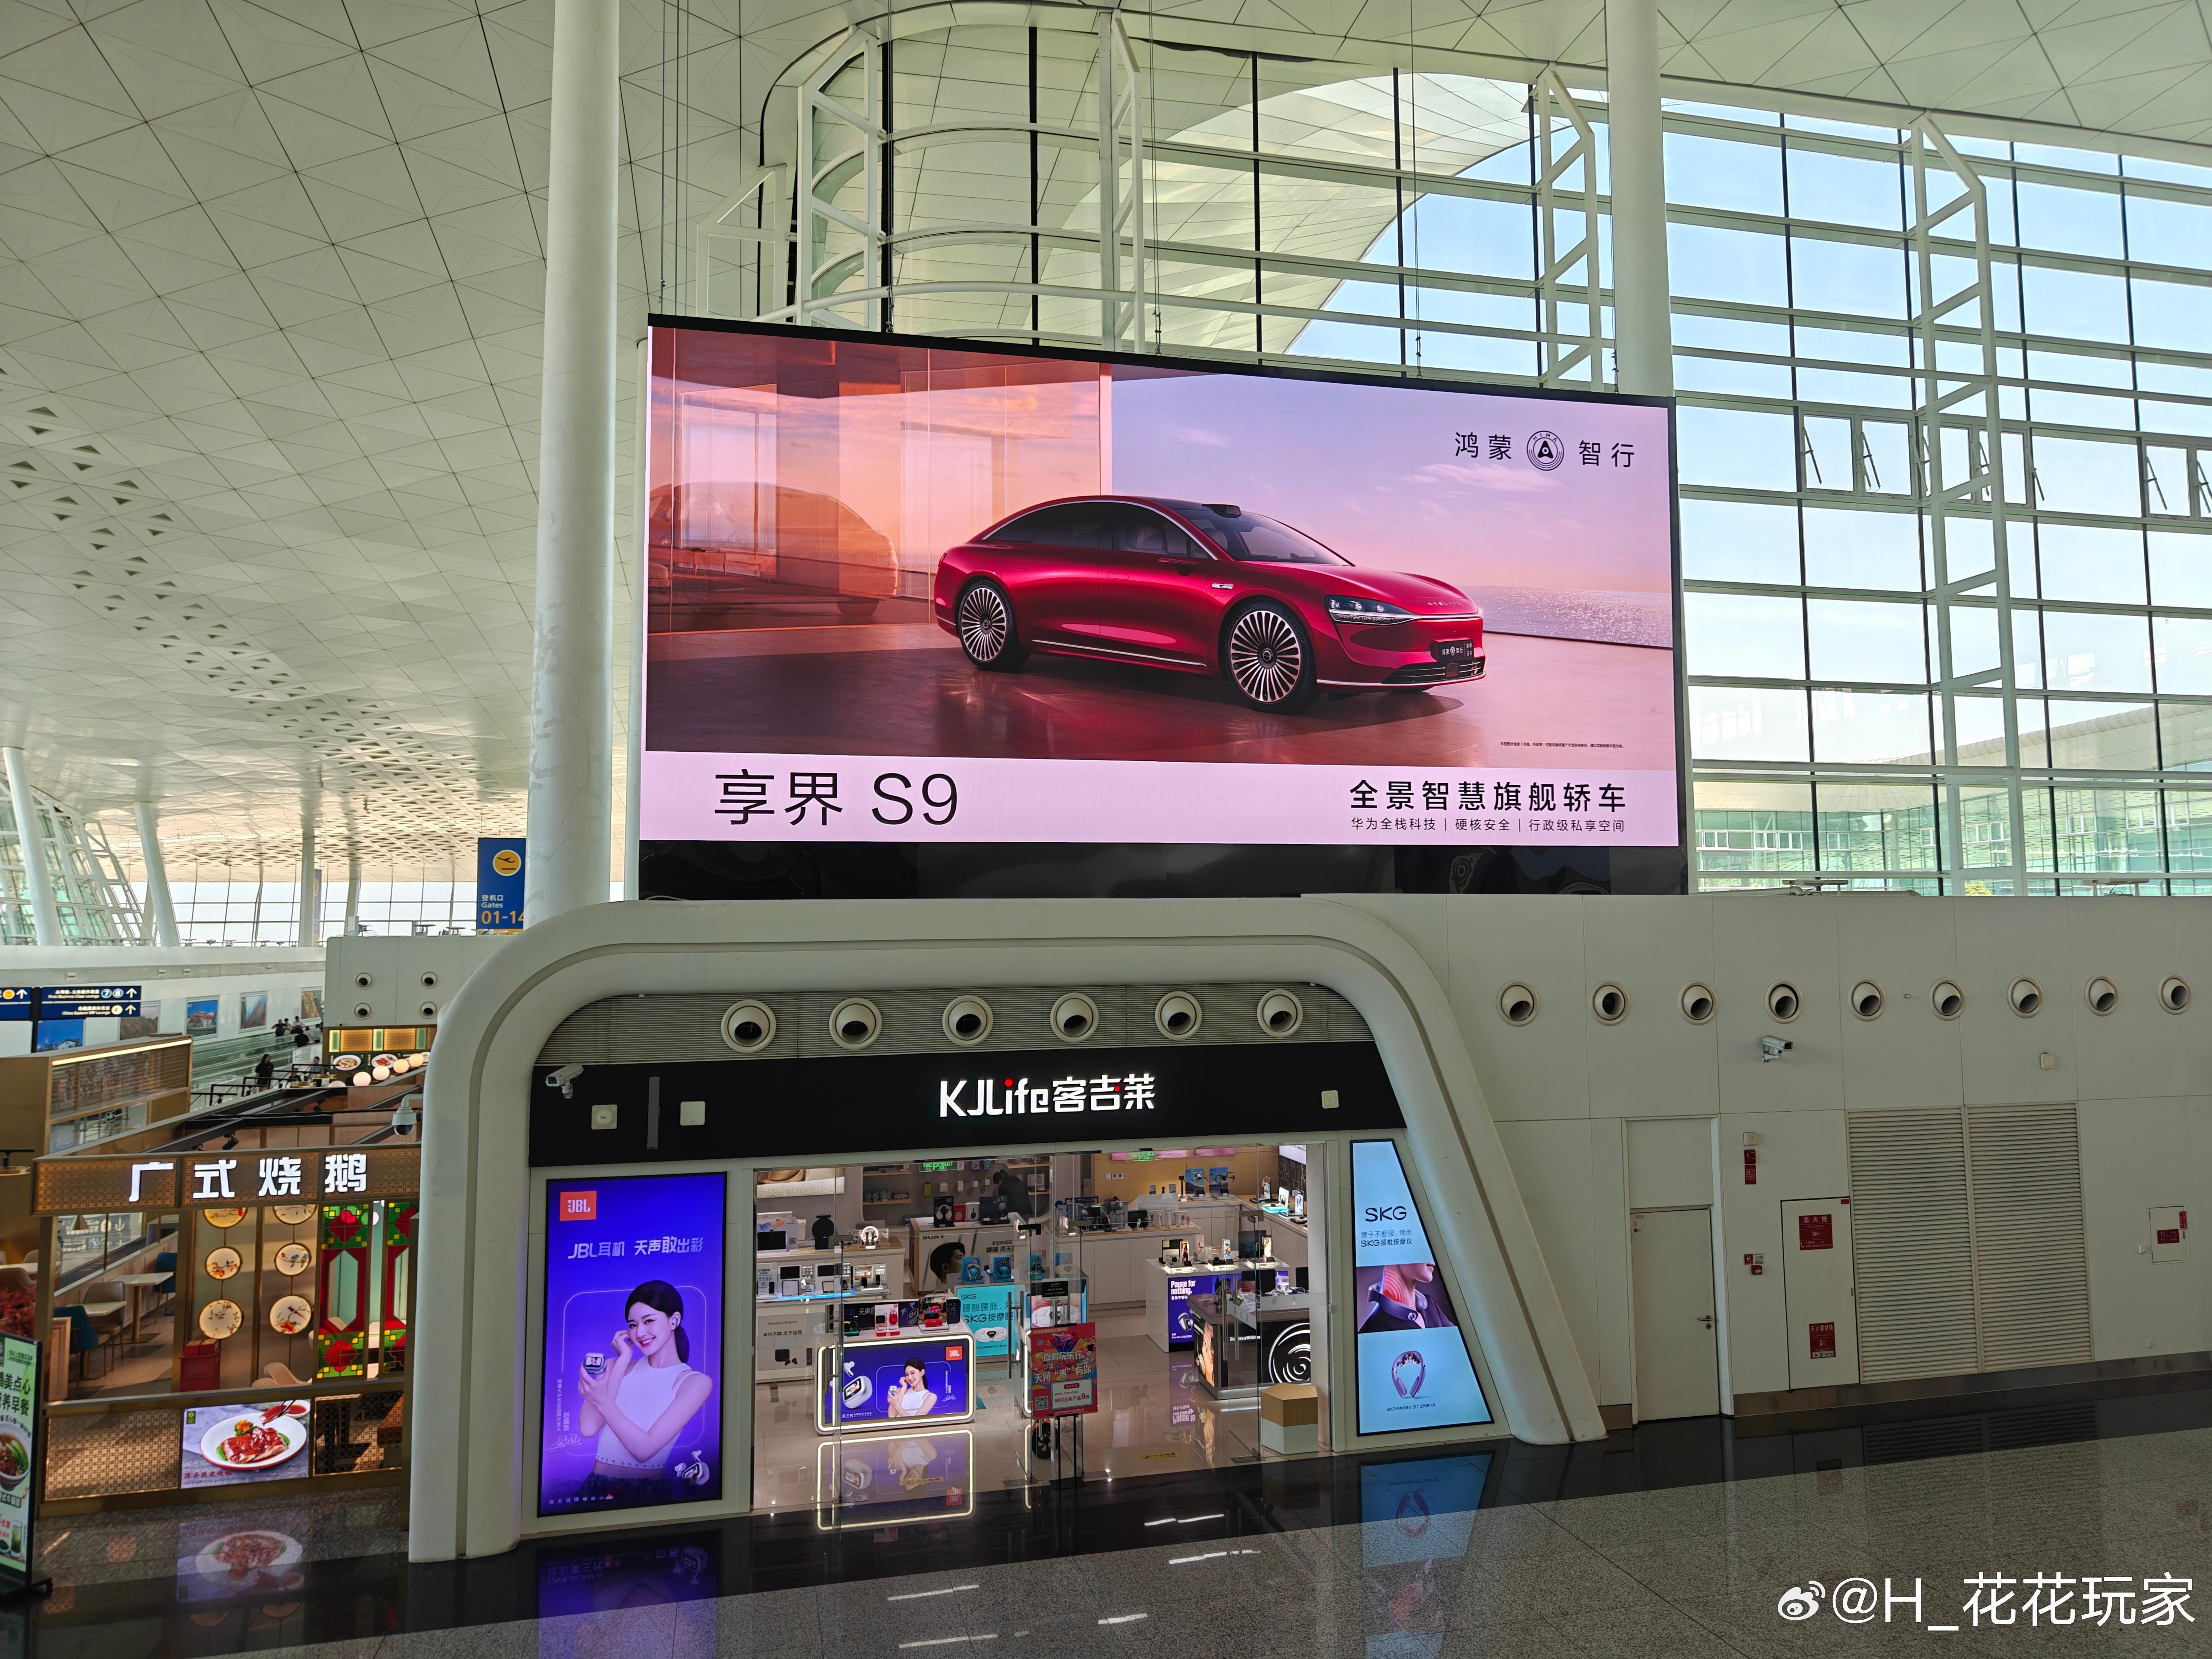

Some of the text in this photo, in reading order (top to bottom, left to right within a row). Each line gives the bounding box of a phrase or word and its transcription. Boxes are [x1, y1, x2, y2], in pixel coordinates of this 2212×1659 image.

[1532, 433, 1557, 442] HIMA
[1455, 432, 1635, 468] 鸿蒙 智行
[715, 769, 957, 825] 享界 S9
[1349, 779, 1626, 812] 全景智慧旗舰轿车
[1351, 817, 1624, 833] 华为全栈科技 硬核安全 行政级私享空间
[940, 1073, 1155, 1117] KJLife 客吉莱
[129, 1153, 367, 1202] 广式烧鹅
[567, 1199, 591, 1213] JBL
[1365, 1206, 1407, 1222] SKG
[568, 1236, 704, 1259] JBL耳机 天声敢出彩
[1361, 1238, 1413, 1247] SKG颈椎按摩仪
[1171, 1287, 1192, 1295] nothing.
[1076, 1364, 1091, 1376] 有你
